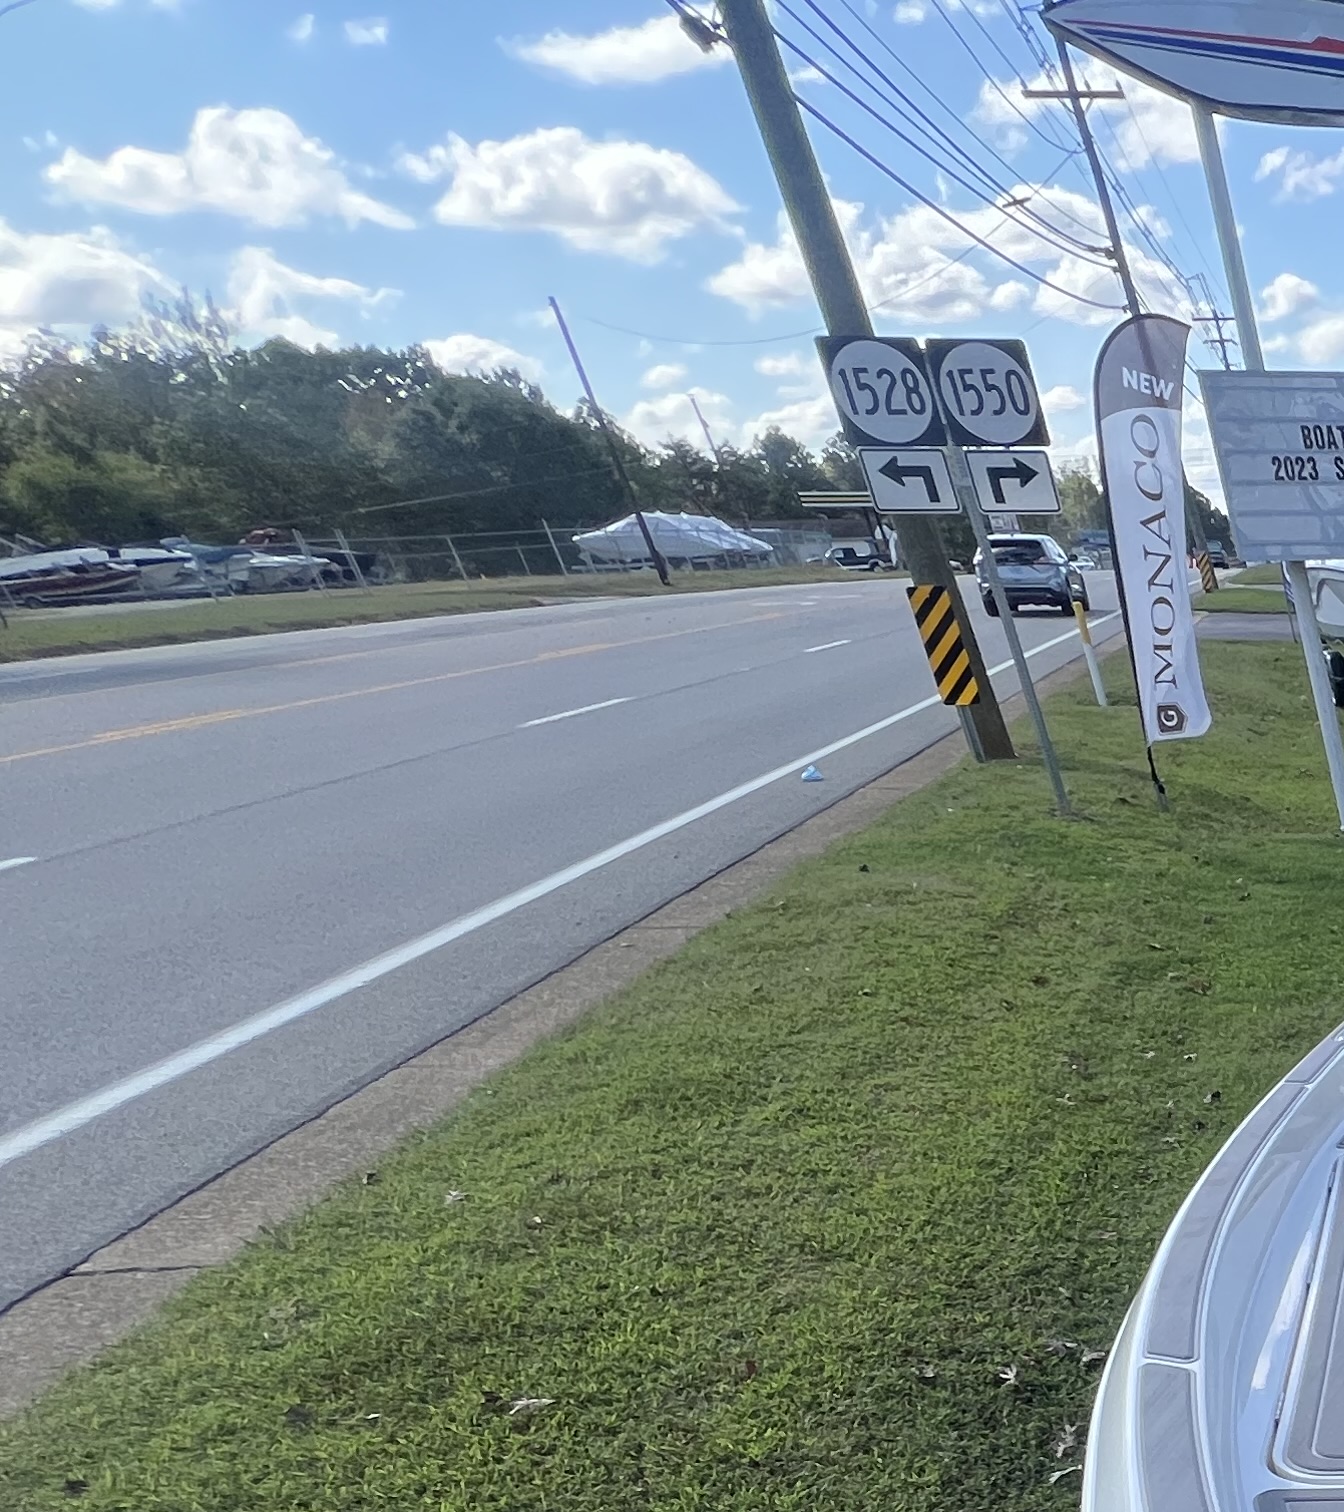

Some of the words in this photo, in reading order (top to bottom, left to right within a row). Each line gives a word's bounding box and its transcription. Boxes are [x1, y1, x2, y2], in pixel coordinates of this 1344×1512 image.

[838, 367, 927, 416] 1528
[946, 368, 1031, 417] 1550
[1121, 366, 1175, 401] NEW
[1271, 455, 1320, 481] 2023
[1130, 413, 1179, 690] MONACO
